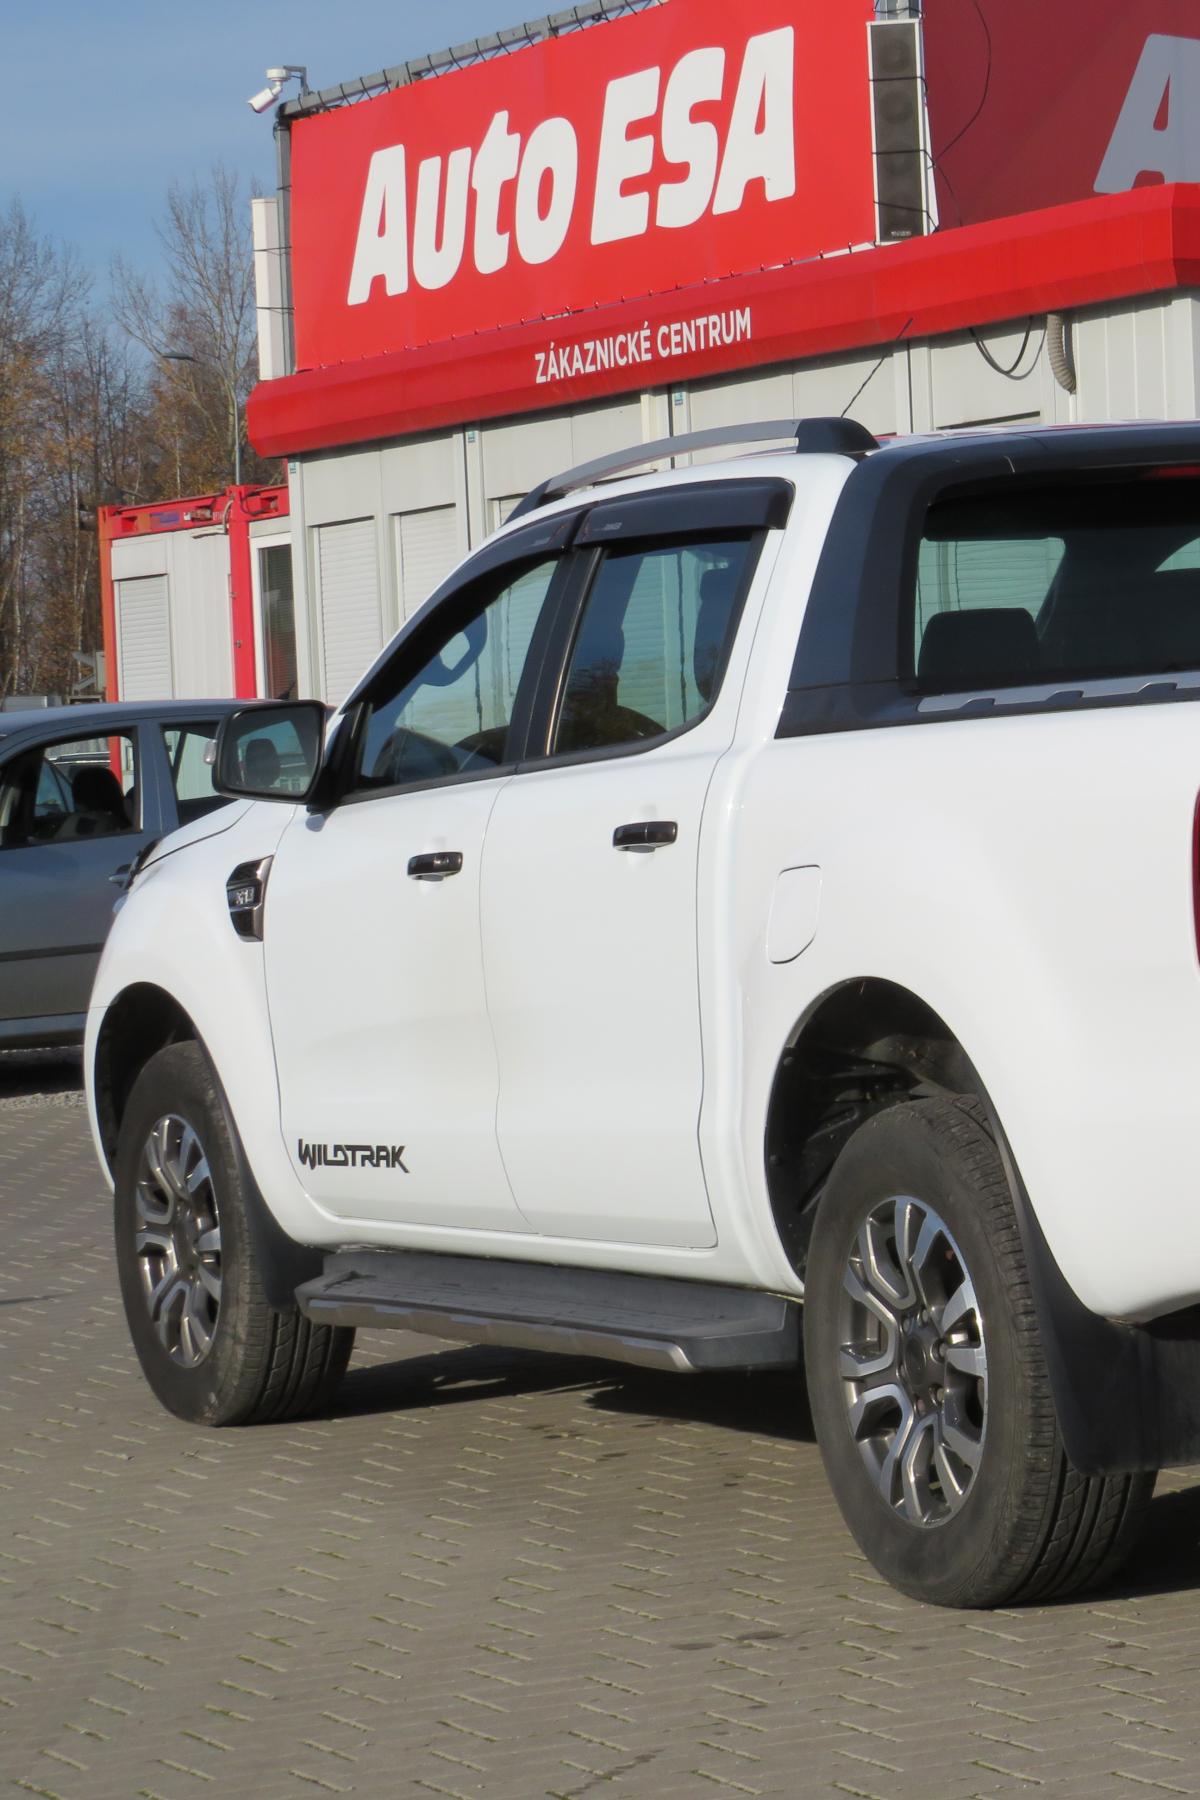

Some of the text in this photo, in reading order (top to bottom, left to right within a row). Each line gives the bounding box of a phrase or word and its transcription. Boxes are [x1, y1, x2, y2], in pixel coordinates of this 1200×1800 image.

[347, 26, 796, 306] Auto ESA
[534, 307, 751, 384] ZÁKAZNICKÉ CENTRUM
[298, 1138, 410, 1173] WILDTRAK
